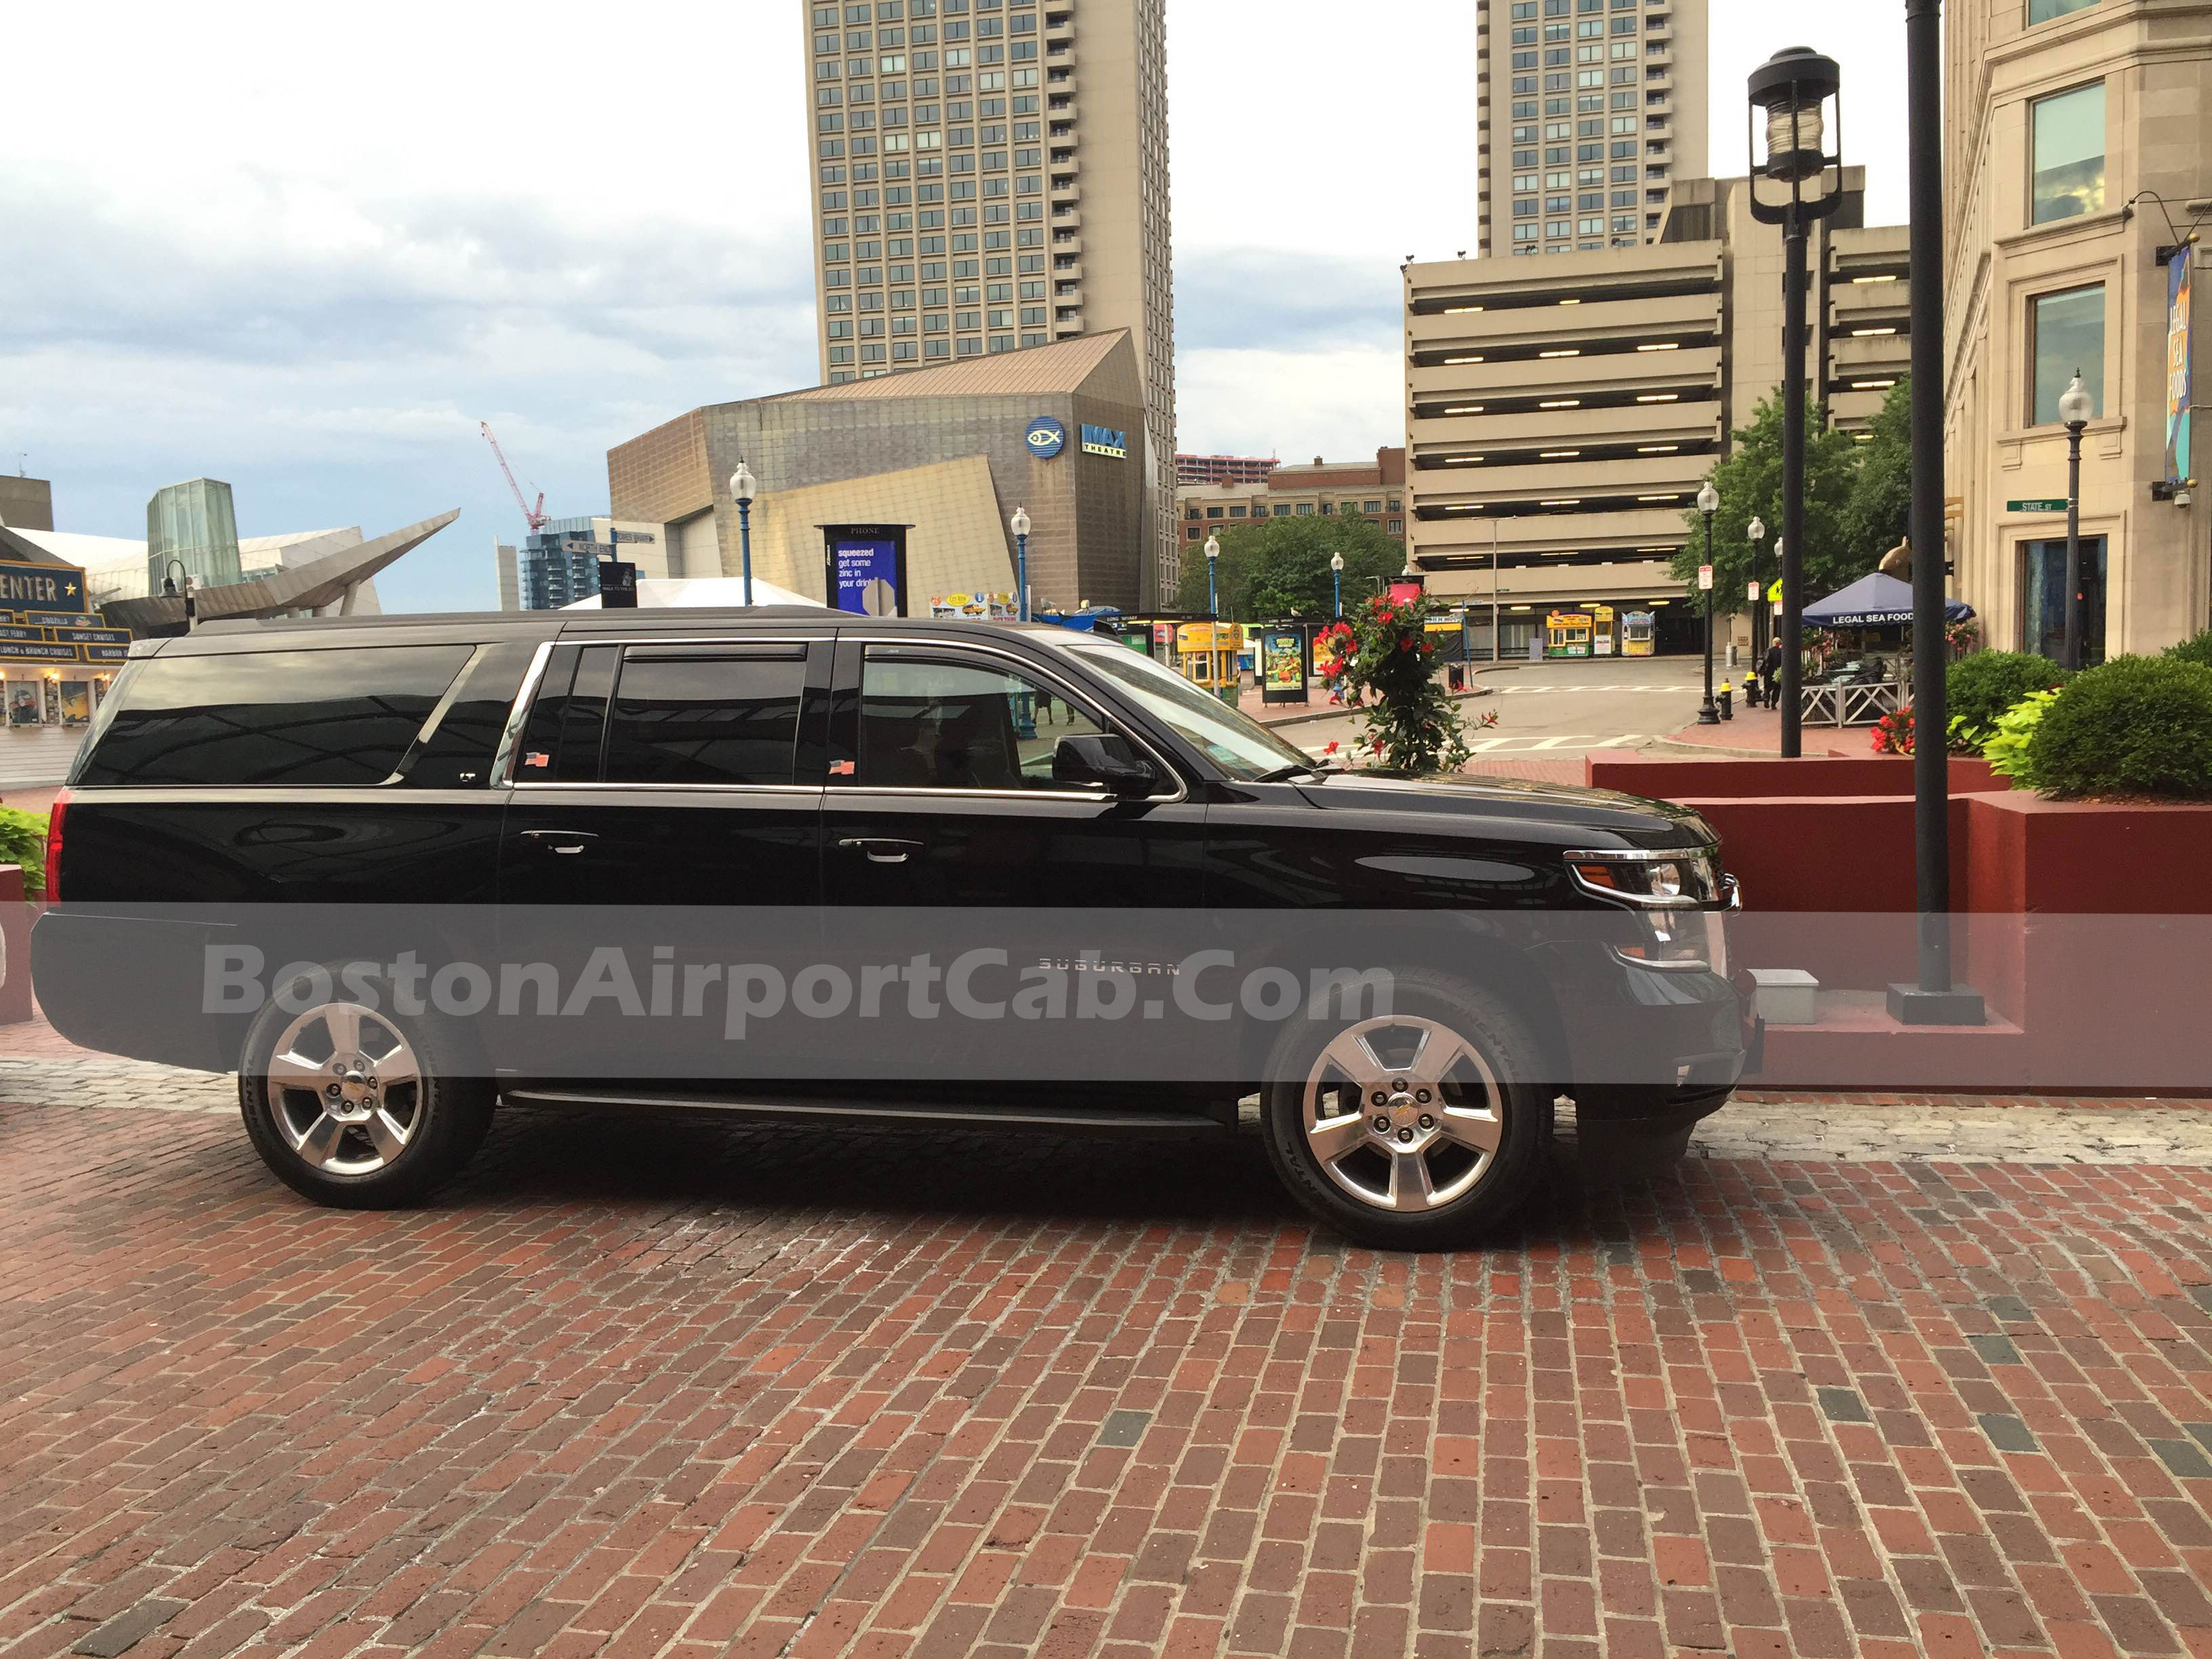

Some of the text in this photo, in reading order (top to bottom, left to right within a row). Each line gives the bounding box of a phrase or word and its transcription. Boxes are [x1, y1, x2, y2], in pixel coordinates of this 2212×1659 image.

[2170, 300, 2186, 336] LEGAL
[2173, 335, 2184, 369] SEA
[2169, 368, 2187, 402] FOODS
[1084, 444, 1127, 457] THEATRE
[2022, 502, 2043, 511] STATE
[838, 548, 874, 558] squeezed
[851, 559, 872, 567] some
[838, 569, 861, 577] zinc in
[0, 574, 58, 602] ENTER
[838, 578, 874, 590] your drin
[1832, 613, 1914, 624] LEGAL SEA FOOD
[1038, 958, 1180, 976] SUBURBAN
